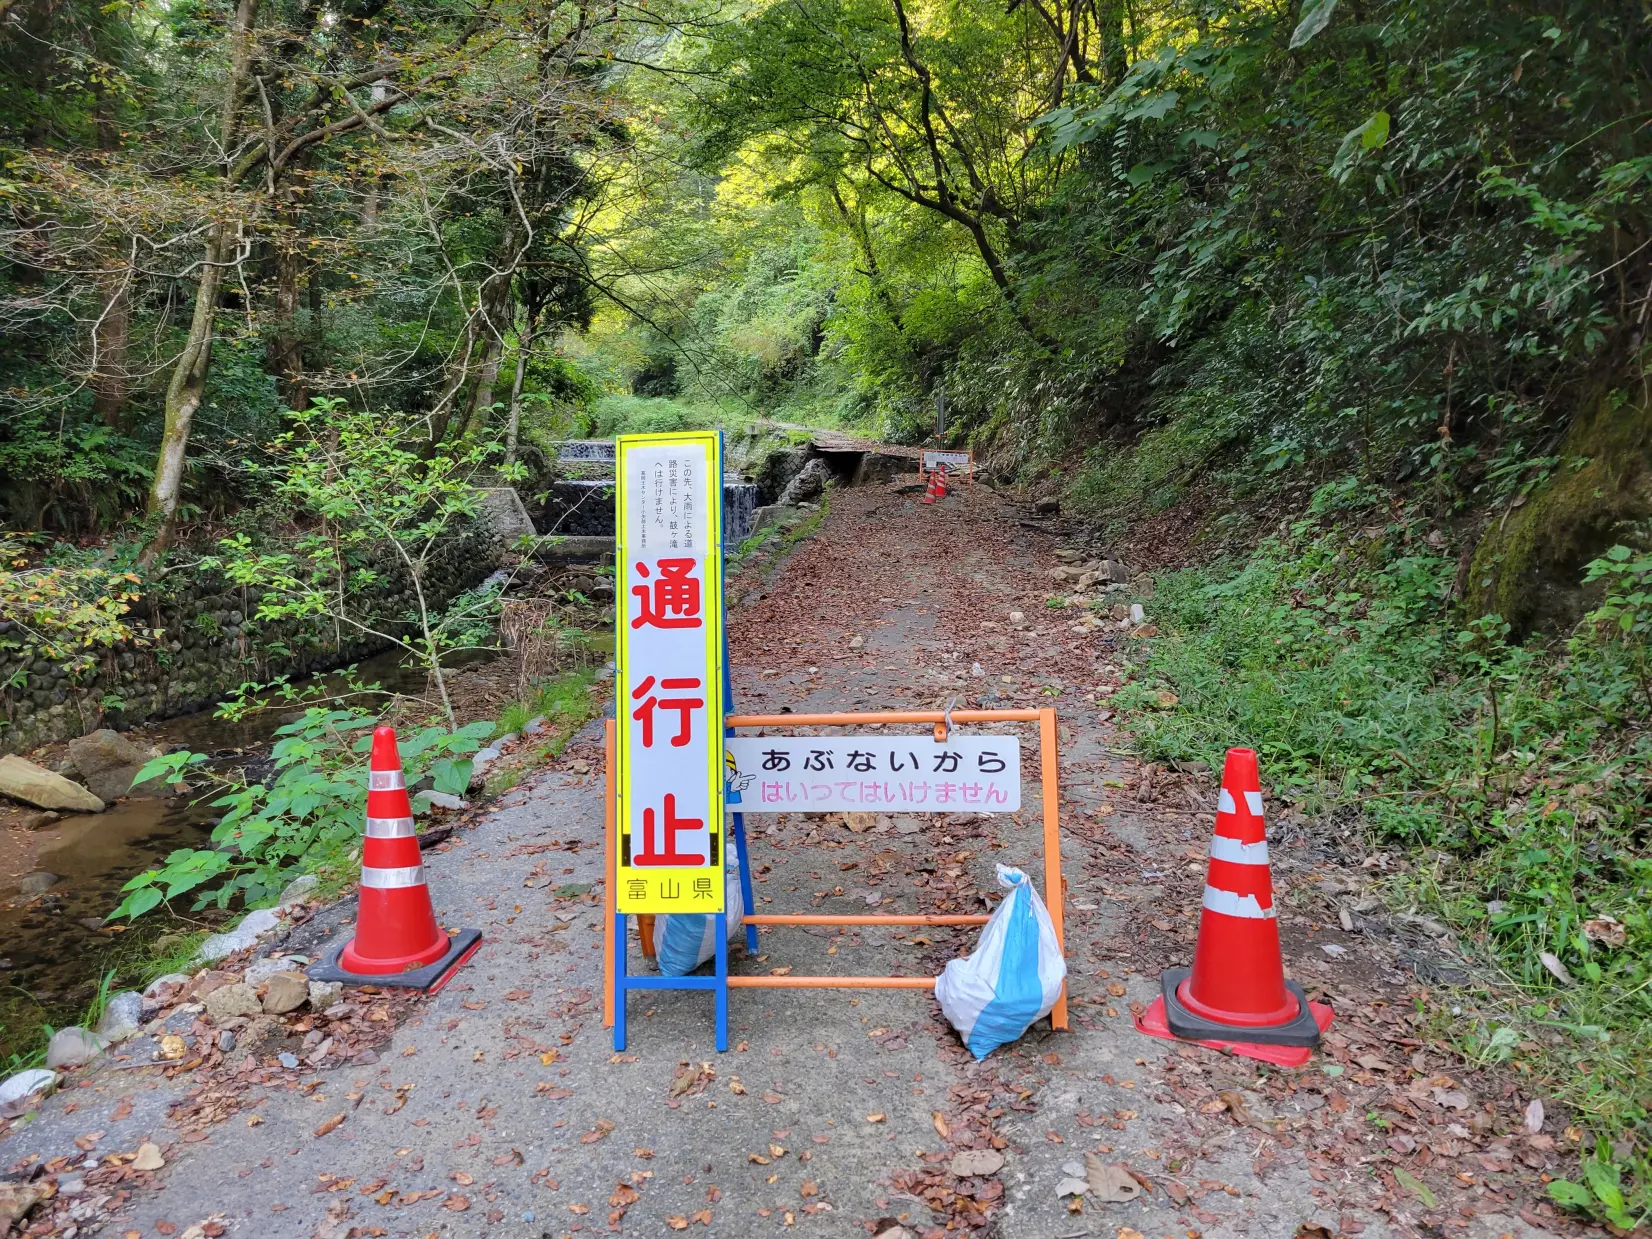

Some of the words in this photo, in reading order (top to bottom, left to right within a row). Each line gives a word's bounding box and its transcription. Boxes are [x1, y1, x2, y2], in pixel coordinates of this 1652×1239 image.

[654, 462, 664, 528] へは行けません。
[683, 459, 693, 548] この先、大雨による道
[631, 558, 705, 866] 通行止
[761, 748, 1007, 774] あぶないから
[761, 781, 1008, 804] はいってはいけません
[626, 877, 714, 900] 富山県
